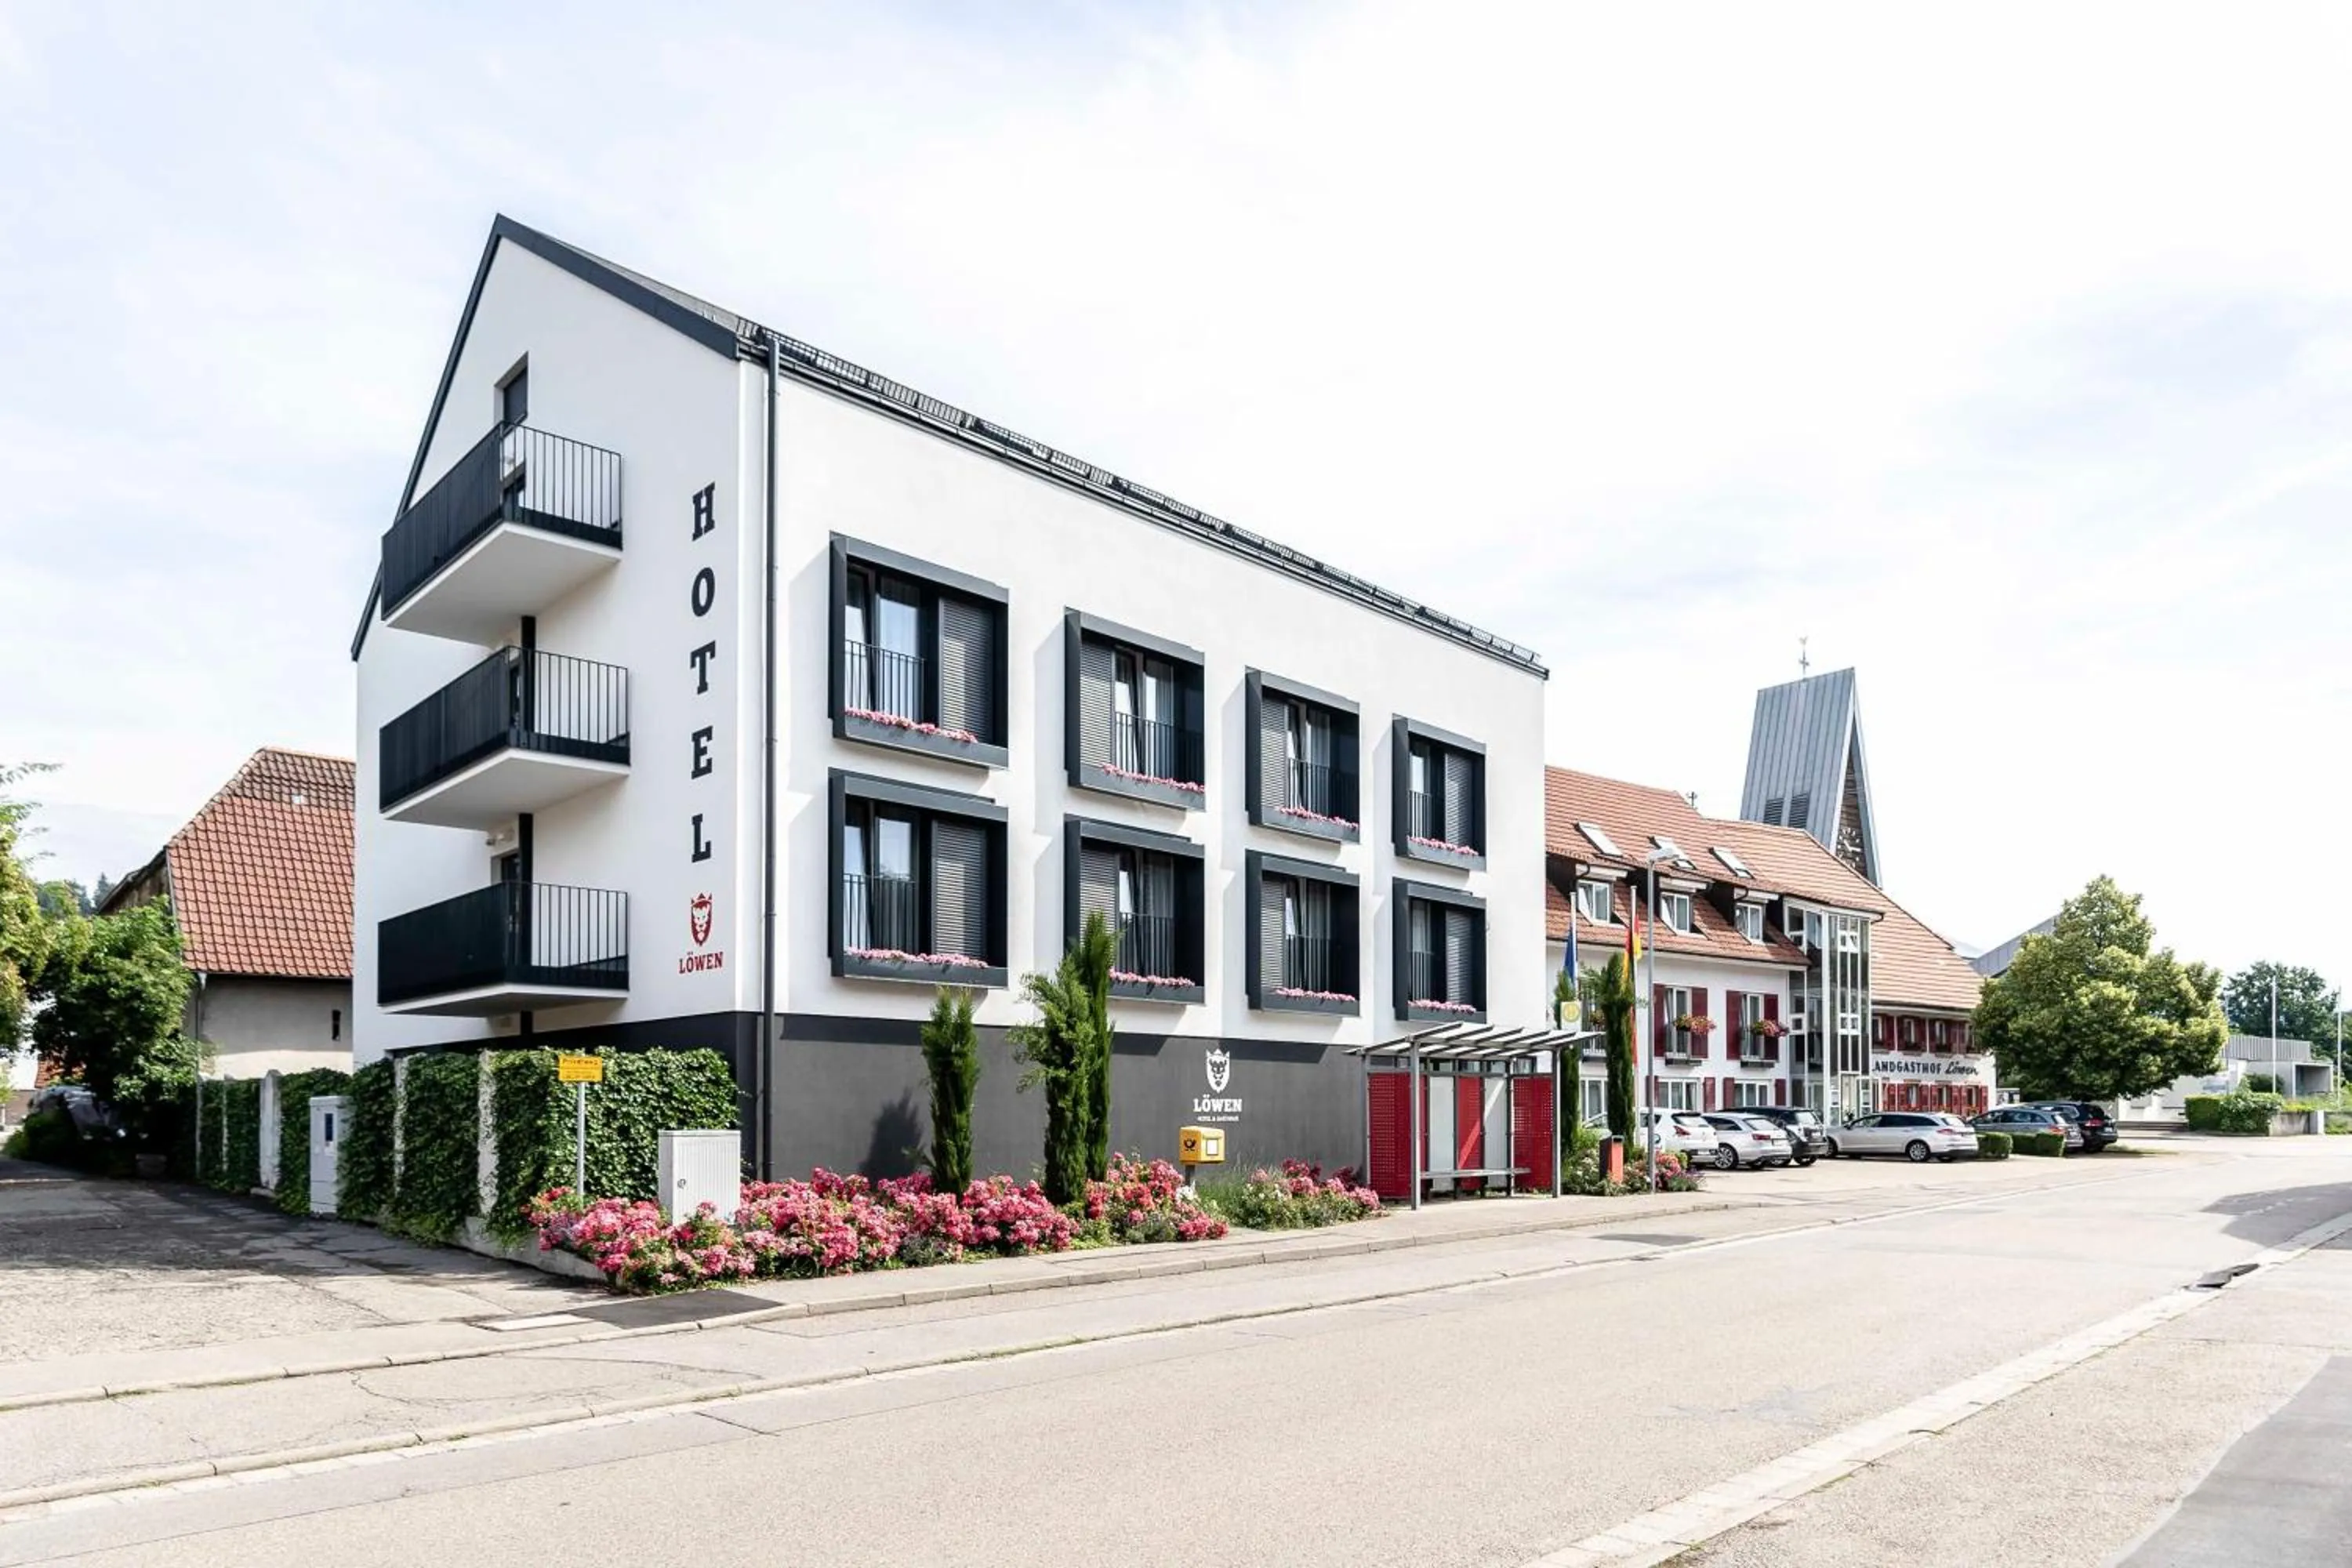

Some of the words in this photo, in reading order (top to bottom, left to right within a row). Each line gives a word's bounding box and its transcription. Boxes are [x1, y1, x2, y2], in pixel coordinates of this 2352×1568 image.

[690, 481, 716, 863] HOTEL
[679, 951, 724, 974] LÖWEN
[1871, 1061, 1942, 1074] ANDGASTHOF
[1192, 1094, 1243, 1112] LÖWEN
